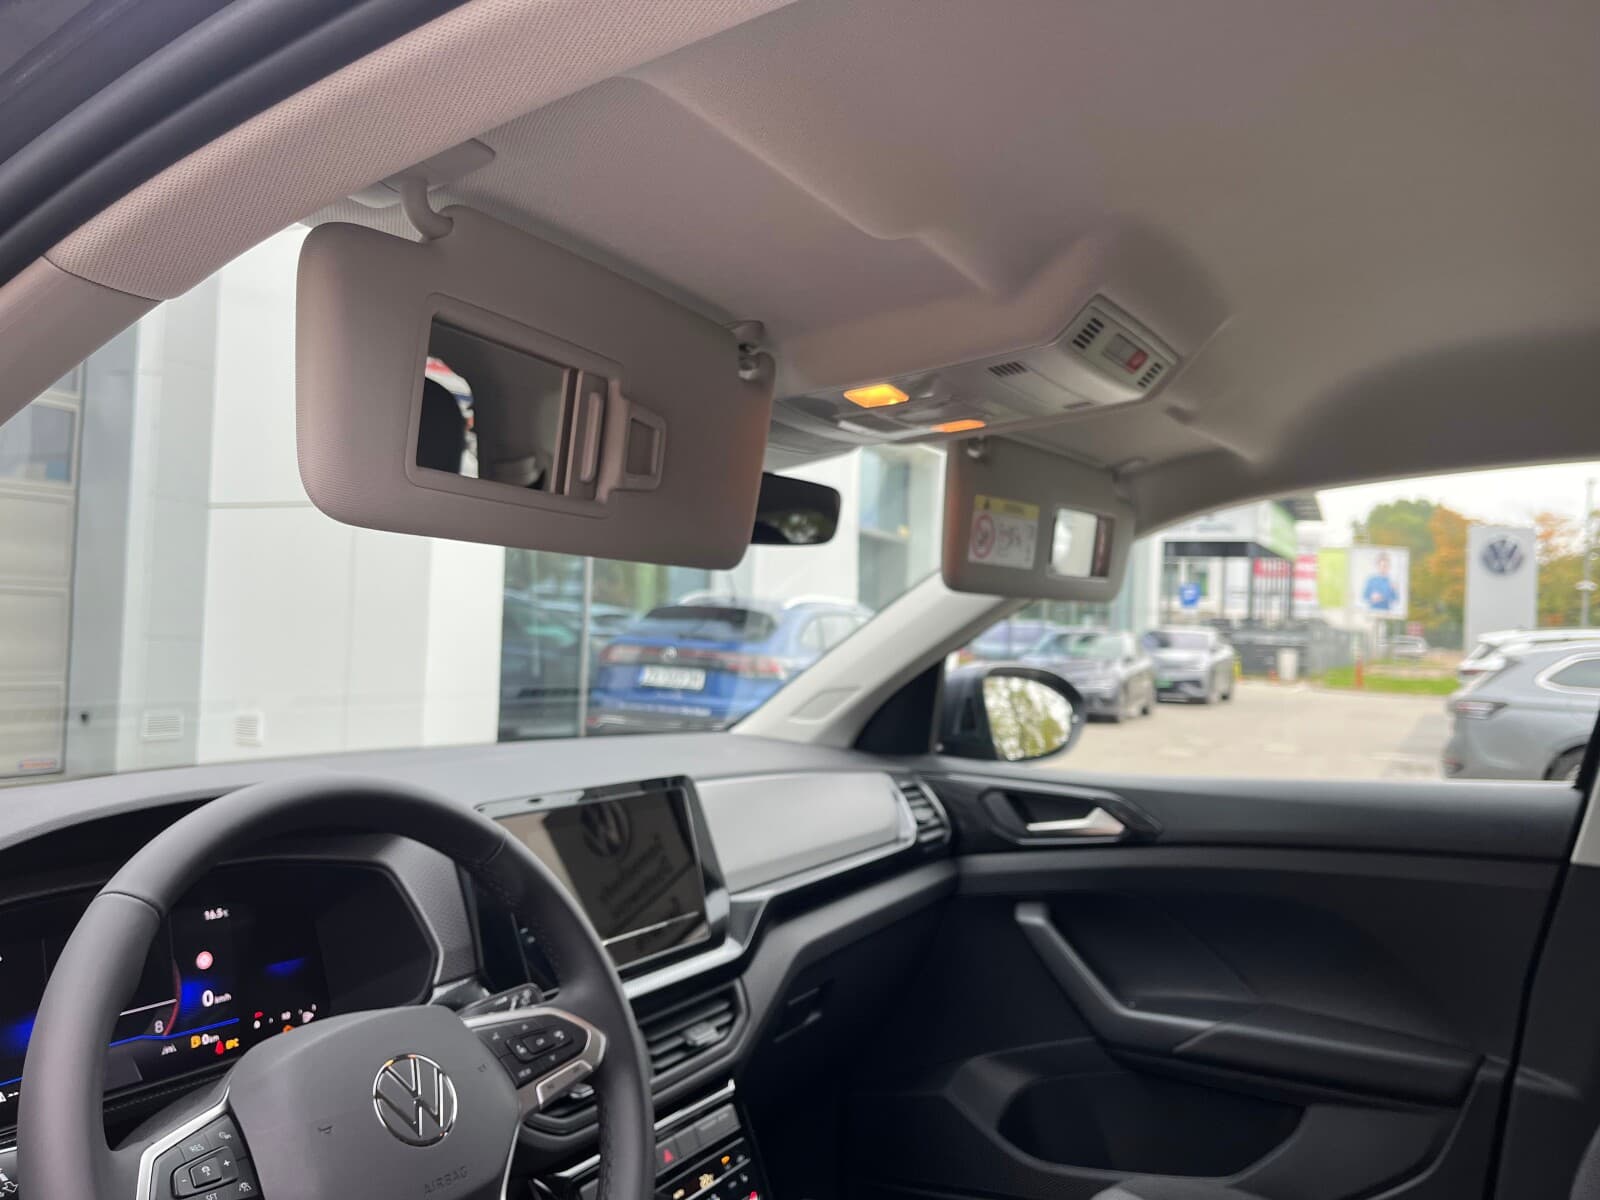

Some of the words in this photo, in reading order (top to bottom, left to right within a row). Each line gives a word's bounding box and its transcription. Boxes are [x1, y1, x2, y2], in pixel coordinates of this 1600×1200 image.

[202, 990, 214, 1007] 0
[155, 1020, 164, 1033] 8
[189, 1143, 205, 1152] RES
[423, 1165, 468, 1195] AIRBAG
